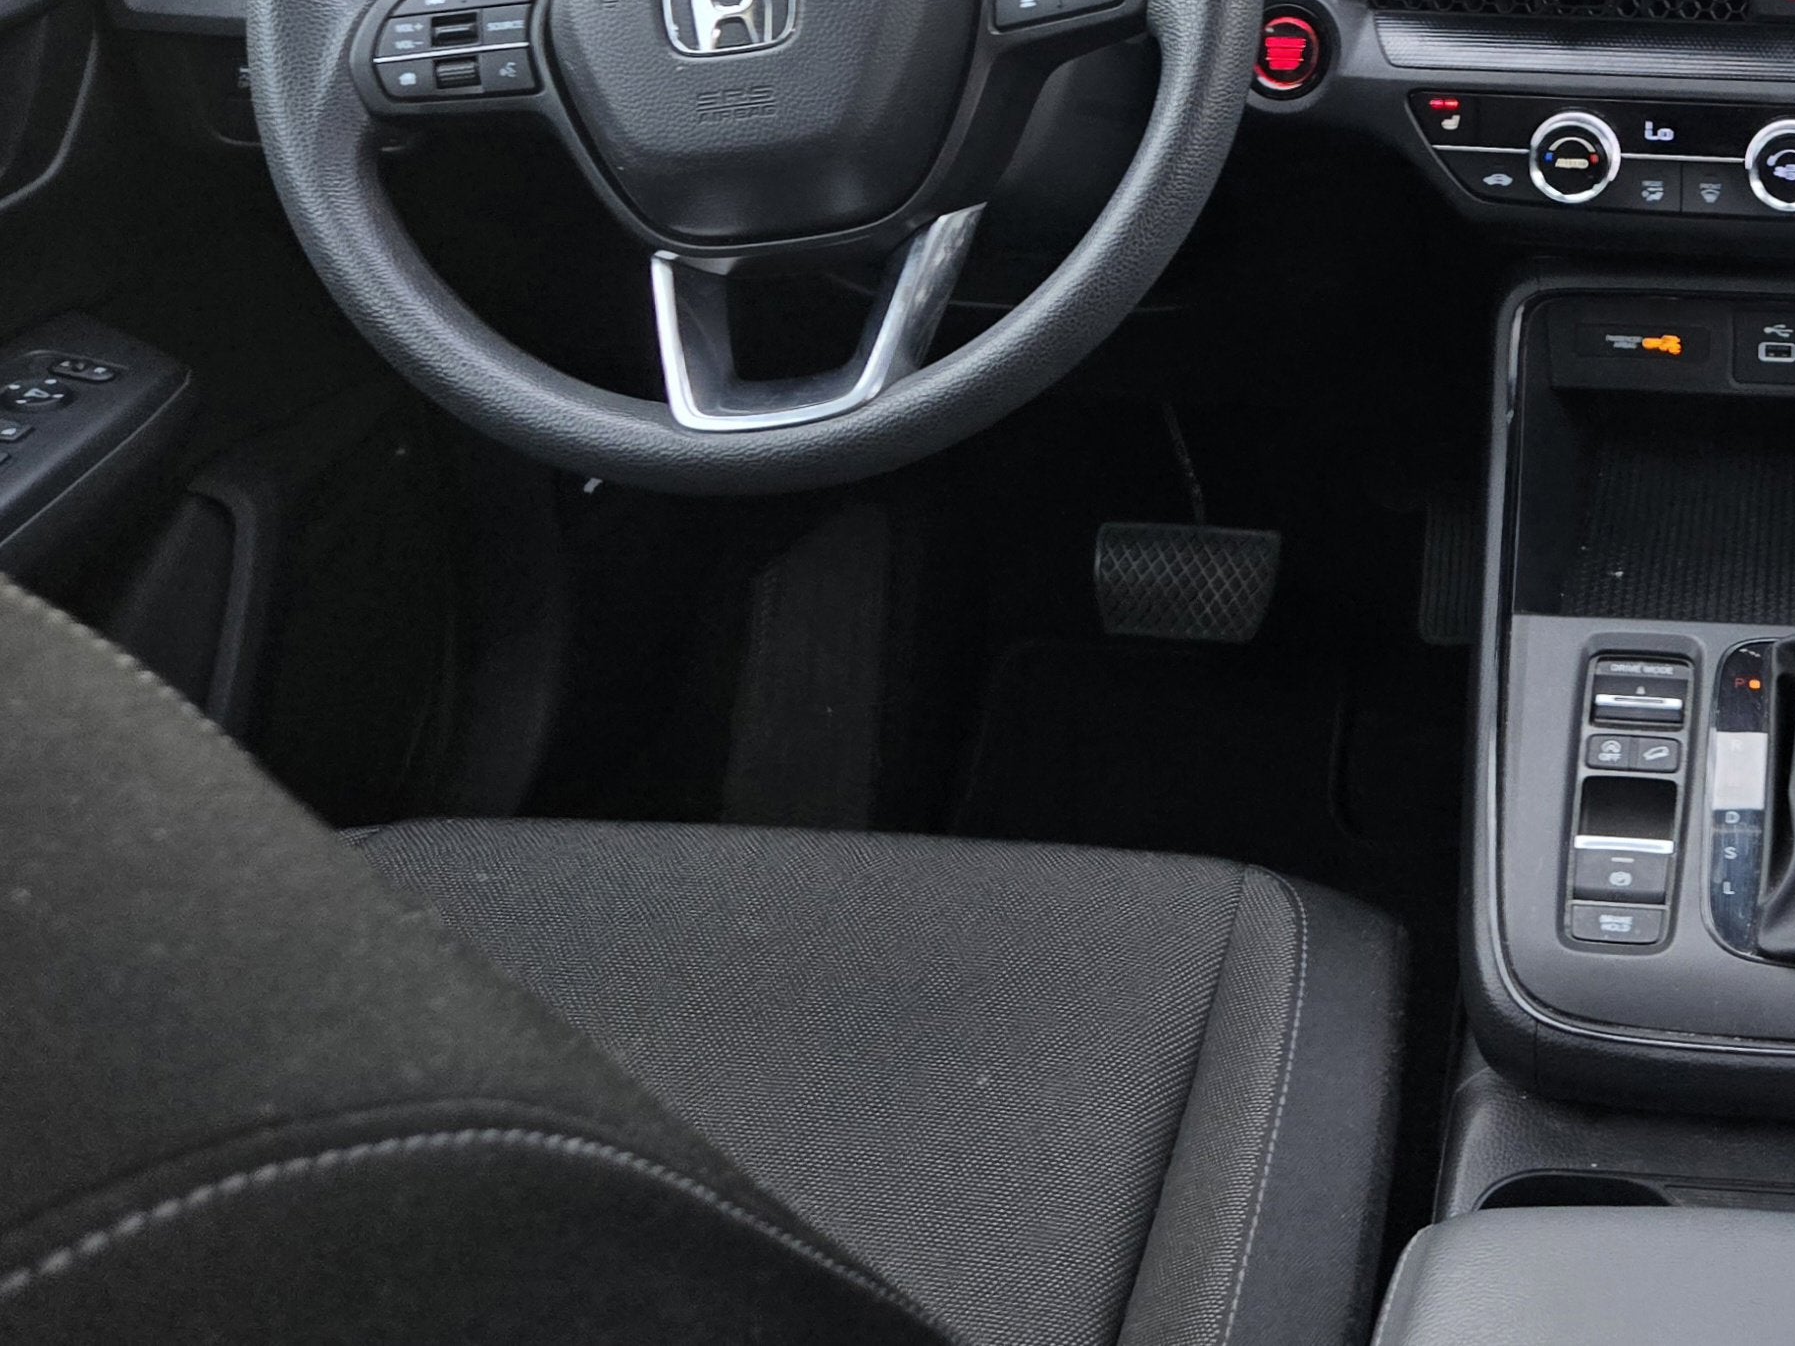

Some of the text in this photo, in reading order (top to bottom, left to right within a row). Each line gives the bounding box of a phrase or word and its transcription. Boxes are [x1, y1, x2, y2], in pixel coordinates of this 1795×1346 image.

[1610, 662, 1675, 676] DRIVE MODE
[1734, 677, 1745, 689] P
[1725, 811, 1741, 824] D
[1724, 846, 1738, 860] S
[1723, 882, 1736, 896] L
